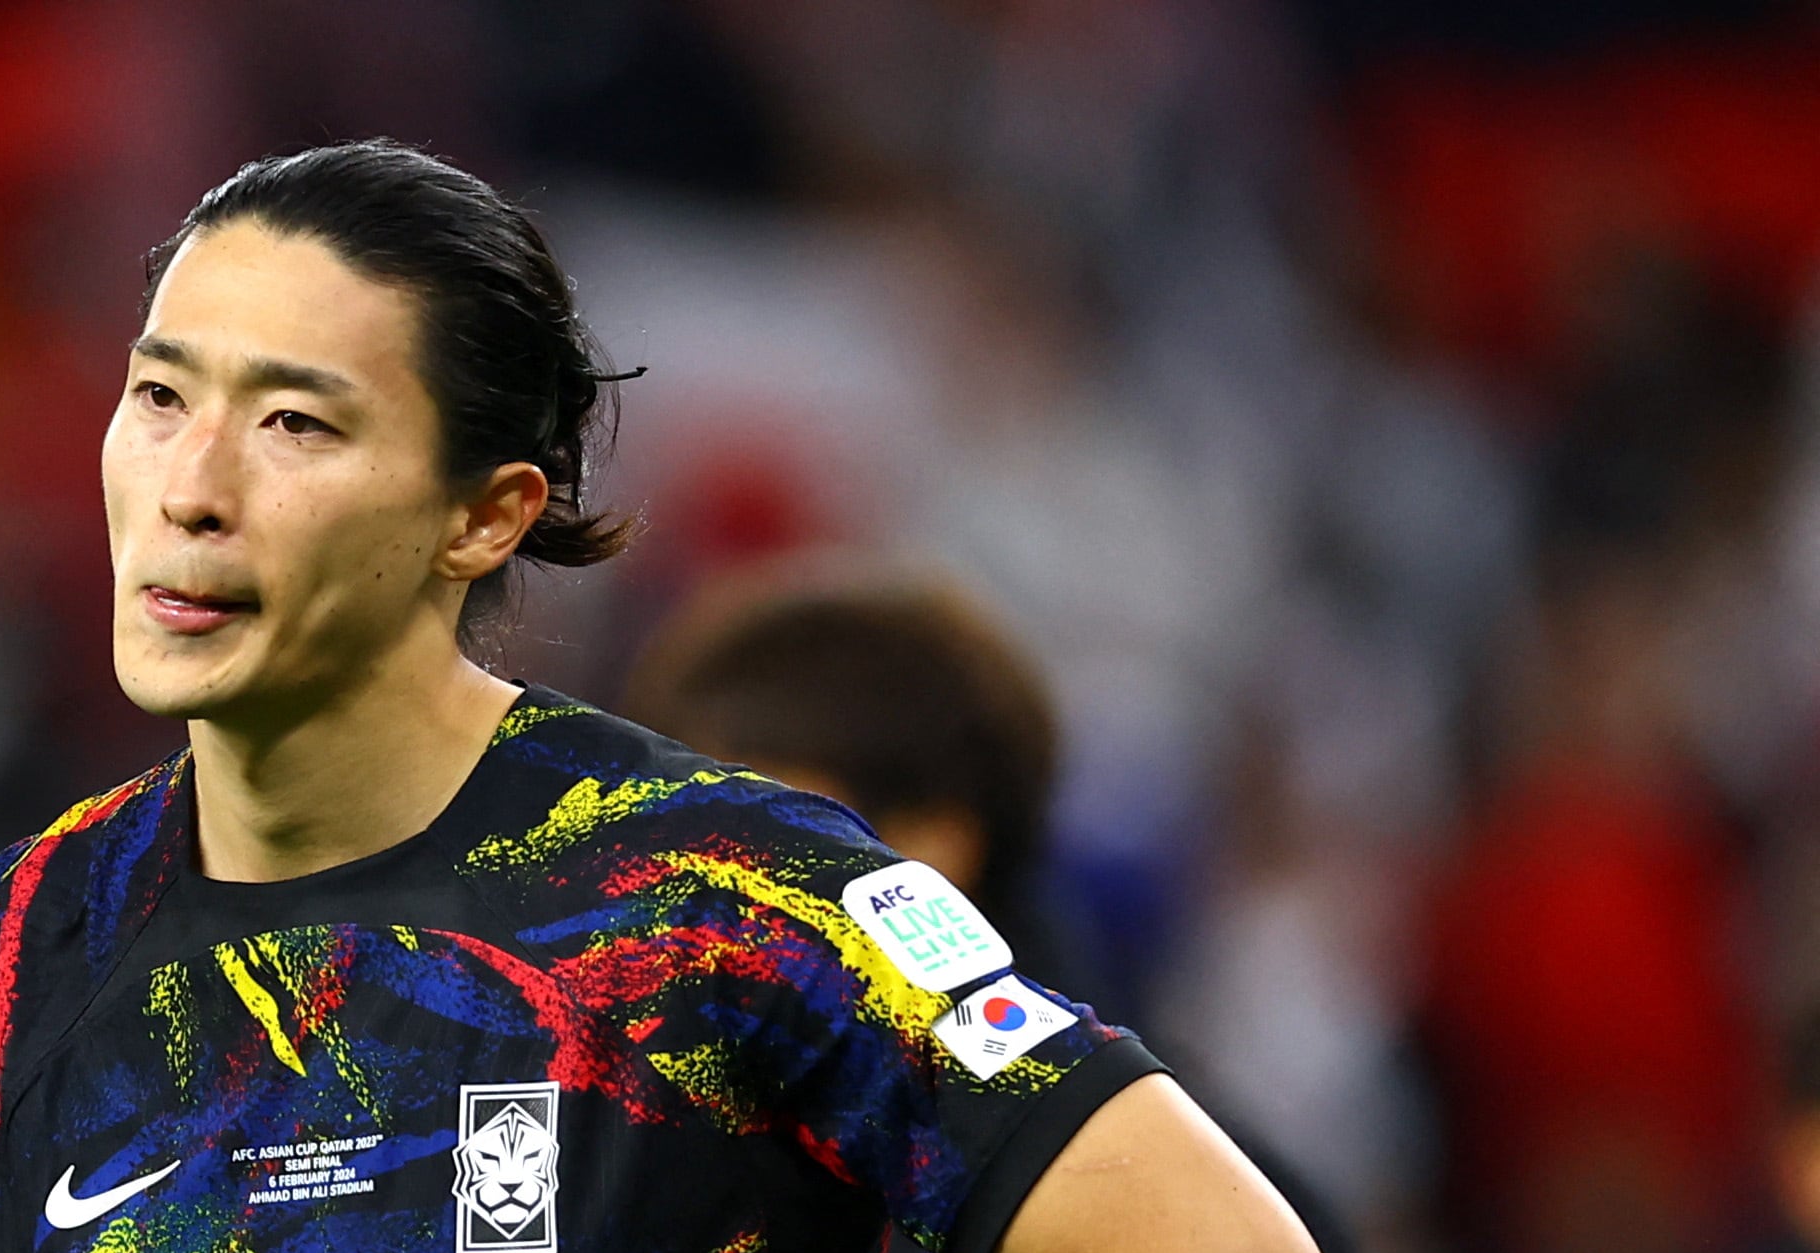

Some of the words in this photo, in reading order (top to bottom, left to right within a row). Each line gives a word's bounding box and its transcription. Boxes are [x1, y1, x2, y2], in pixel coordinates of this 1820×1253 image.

[868, 884, 915, 914] AFC
[882, 896, 965, 943] LIVE
[232, 1148, 256, 1162] AFC
[258, 1145, 294, 1160] ASIAN
[295, 1142, 318, 1156] CUP
[319, 1138, 353, 1153] QATAR
[285, 1158, 311, 1172] SEMI
[313, 1155, 342, 1169] FINAL
[268, 1176, 276, 1188] 6
[279, 1171, 331, 1187] FEBRUARY
[333, 1167, 356, 1182] 2024
[248, 1190, 290, 1205] AHMAD
[292, 1187, 310, 1201] BIN
[312, 1185, 328, 1198] ALI
[330, 1179, 374, 1197] STADIUM
